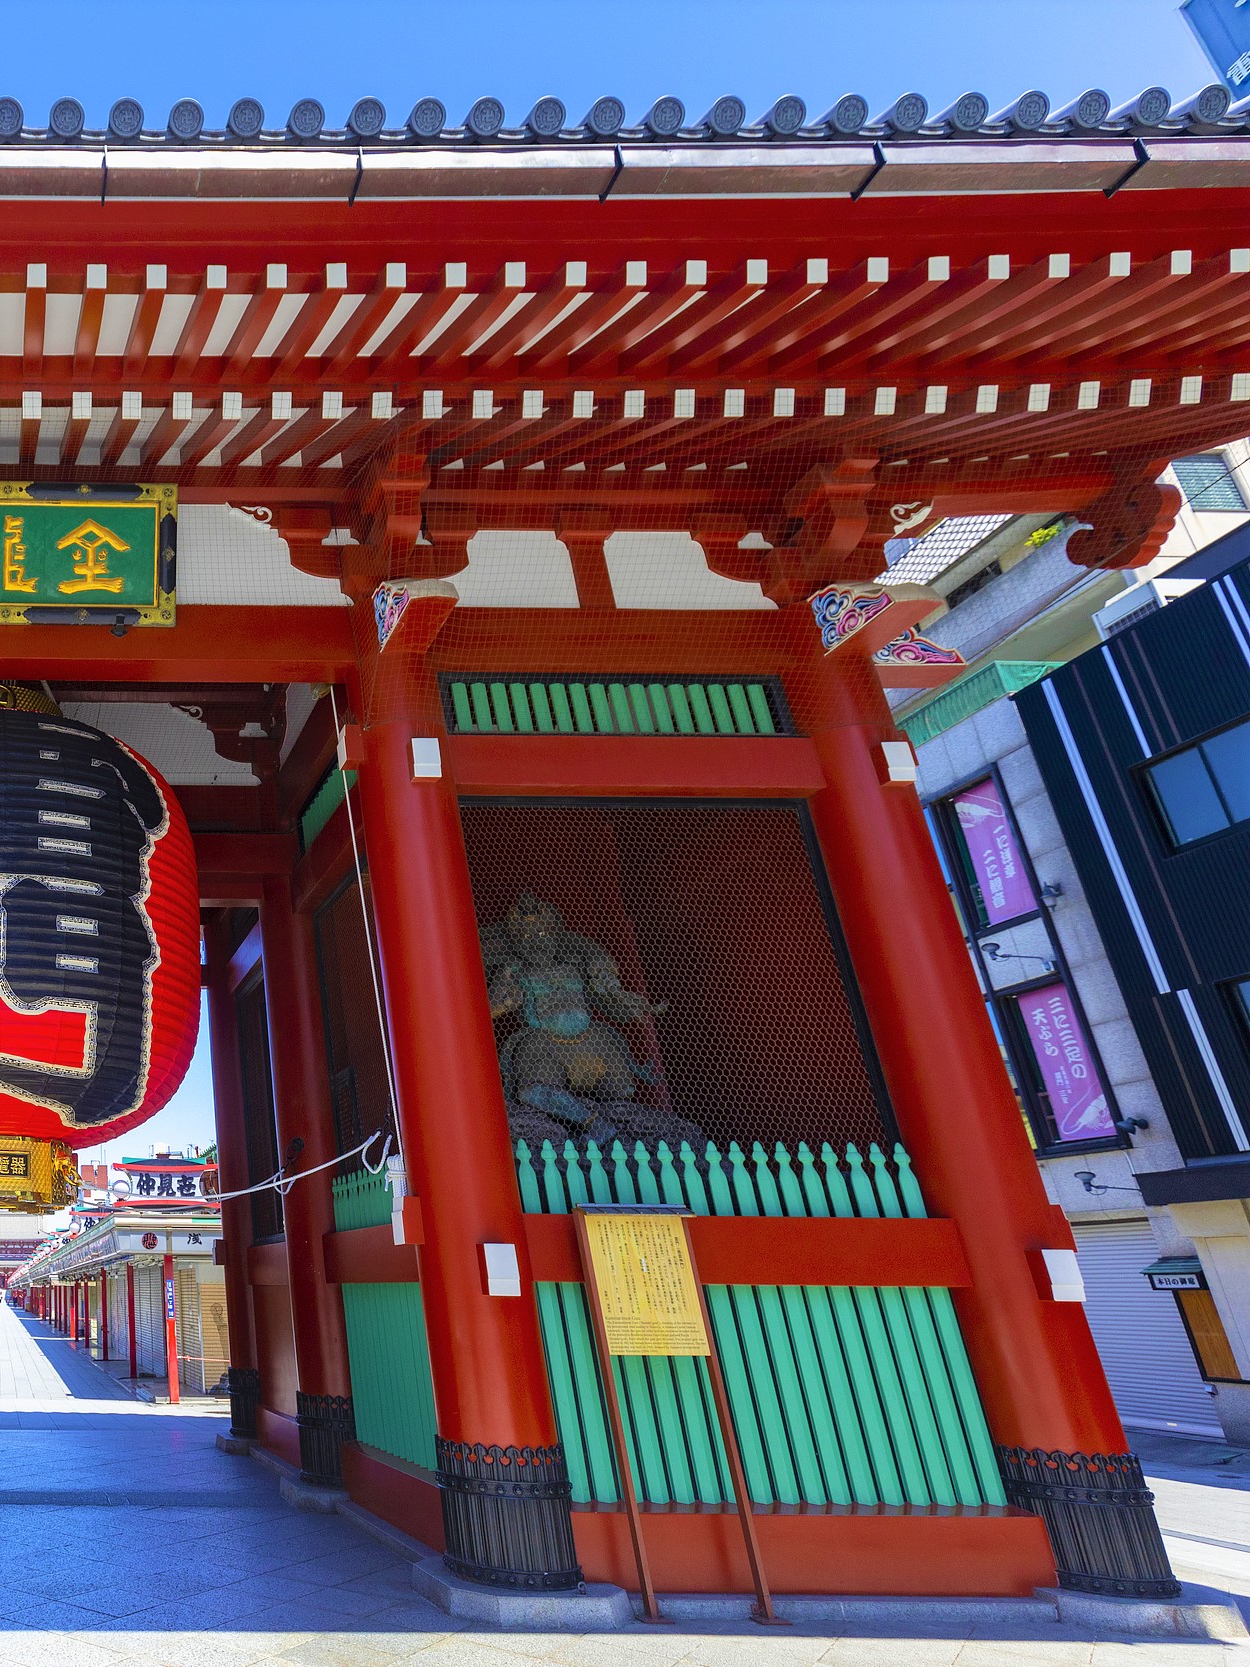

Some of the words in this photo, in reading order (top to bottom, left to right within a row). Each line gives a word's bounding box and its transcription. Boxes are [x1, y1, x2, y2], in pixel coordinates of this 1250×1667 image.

[1031, 1008, 1059, 1056] 天ぷら
[137, 1173, 196, 1197] 仲見世
[187, 1233, 203, 1245] 浅
